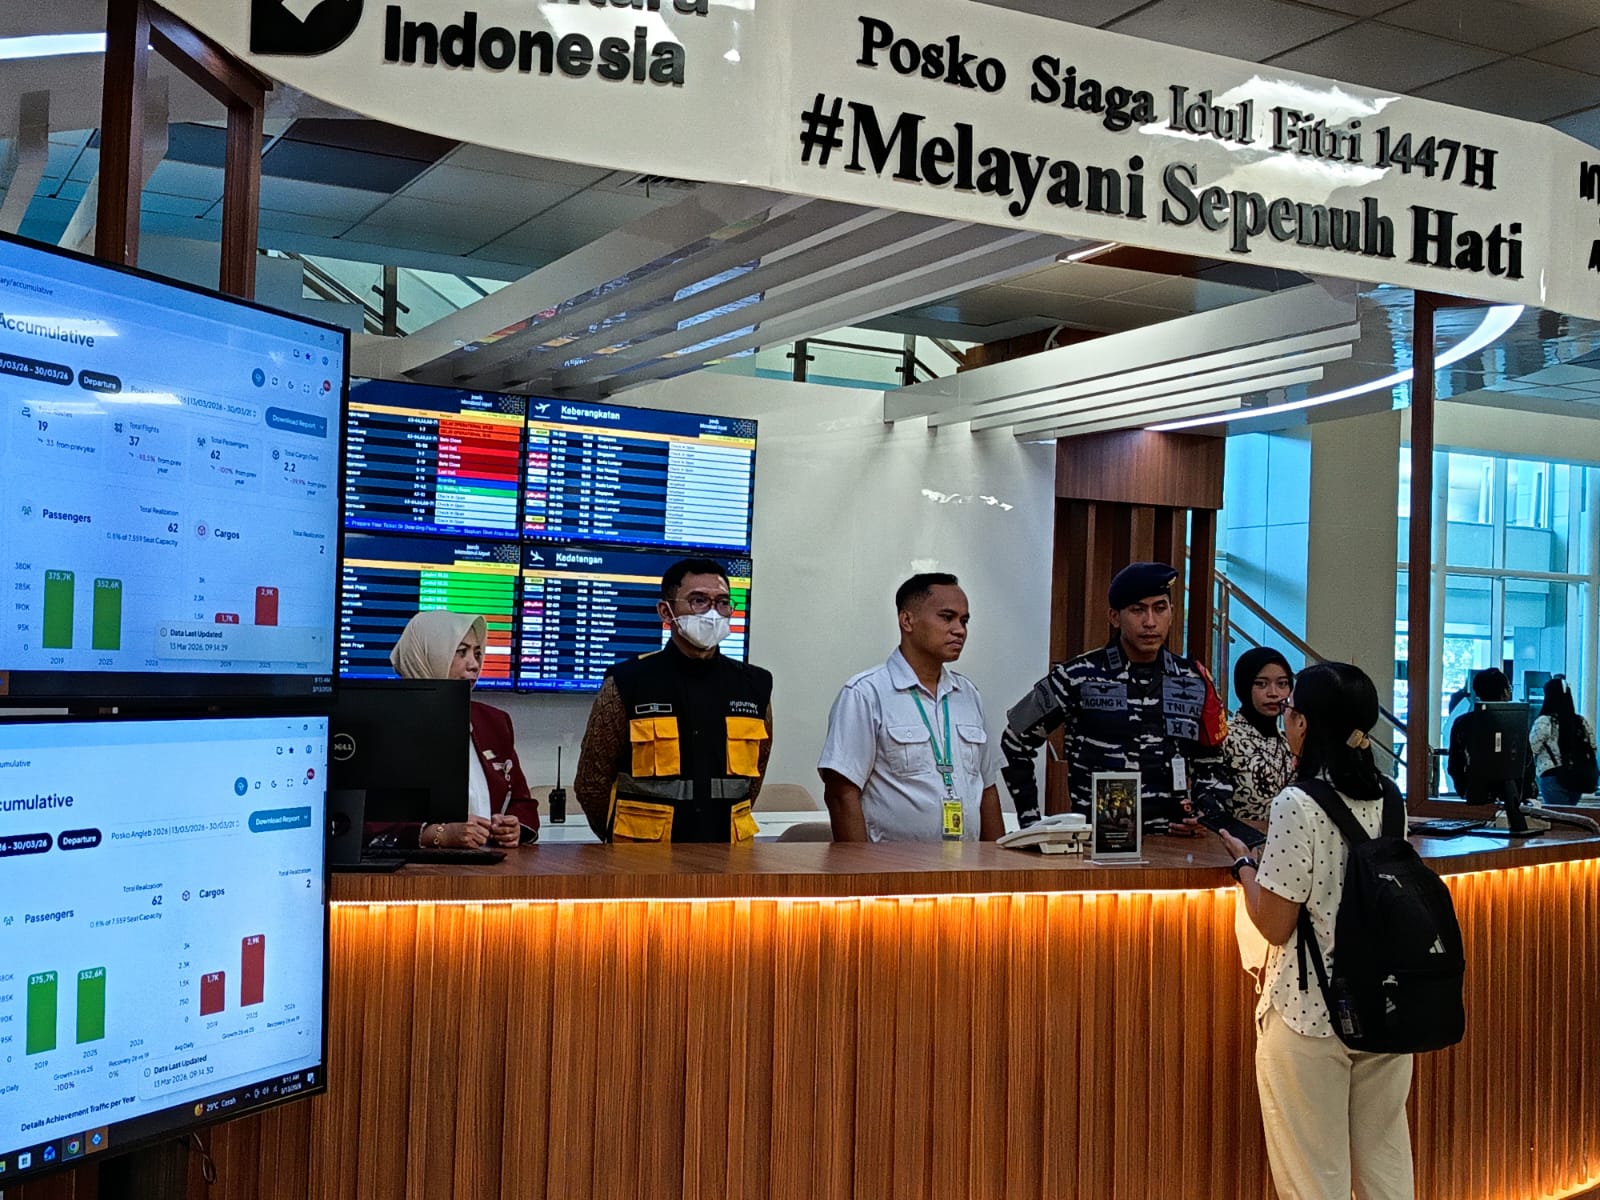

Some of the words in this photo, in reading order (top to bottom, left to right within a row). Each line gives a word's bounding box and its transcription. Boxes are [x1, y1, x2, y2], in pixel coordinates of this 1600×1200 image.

[384, 5, 686, 85] Indonesia
[856, 15, 1006, 93] Posko
[1031, 54, 1158, 132] Siaga
[1168, 84, 1256, 144] Idul
[1270, 105, 1364, 163] Fitri
[1374, 126, 1499, 190] 1447H
[800, 93, 1147, 217] #Melayani
[1162, 161, 1397, 254] Sepenuh
[1409, 204, 1524, 280] Hati
[83, 375, 117, 390] Departure
[561, 405, 621, 420] Keberangkatan
[38, 420, 48, 432] 19
[129, 436, 140, 447] 37
[210, 450, 221, 461] 62
[42, 508, 91, 524] Passengers
[167, 522, 179, 534] 62
[214, 528, 240, 541] Cargos
[319, 545, 325, 555] 2
[555, 553, 603, 565] Kedatangan
[170, 629, 184, 637] Data
[197, 631, 222, 640] Updated
[1166, 702, 1185, 713] TNI
[13, 839, 48, 851] 30/03/26
[62, 834, 97, 846] Departure
[306, 878, 311, 888] 2
[199, 887, 225, 899] Cargos
[151, 895, 163, 906] 62
[25, 909, 75, 924] Passengers
[153, 1064, 168, 1075] Data
[168, 1060, 182, 1071] Last
[182, 1054, 208, 1070] Updated
[20, 1119, 45, 1132] Details
[46, 1107, 89, 1126] Achievement
[90, 1101, 110, 1114] Traffic
[110, 1099, 122, 1110] per
[122, 1095, 136, 1105] Year
